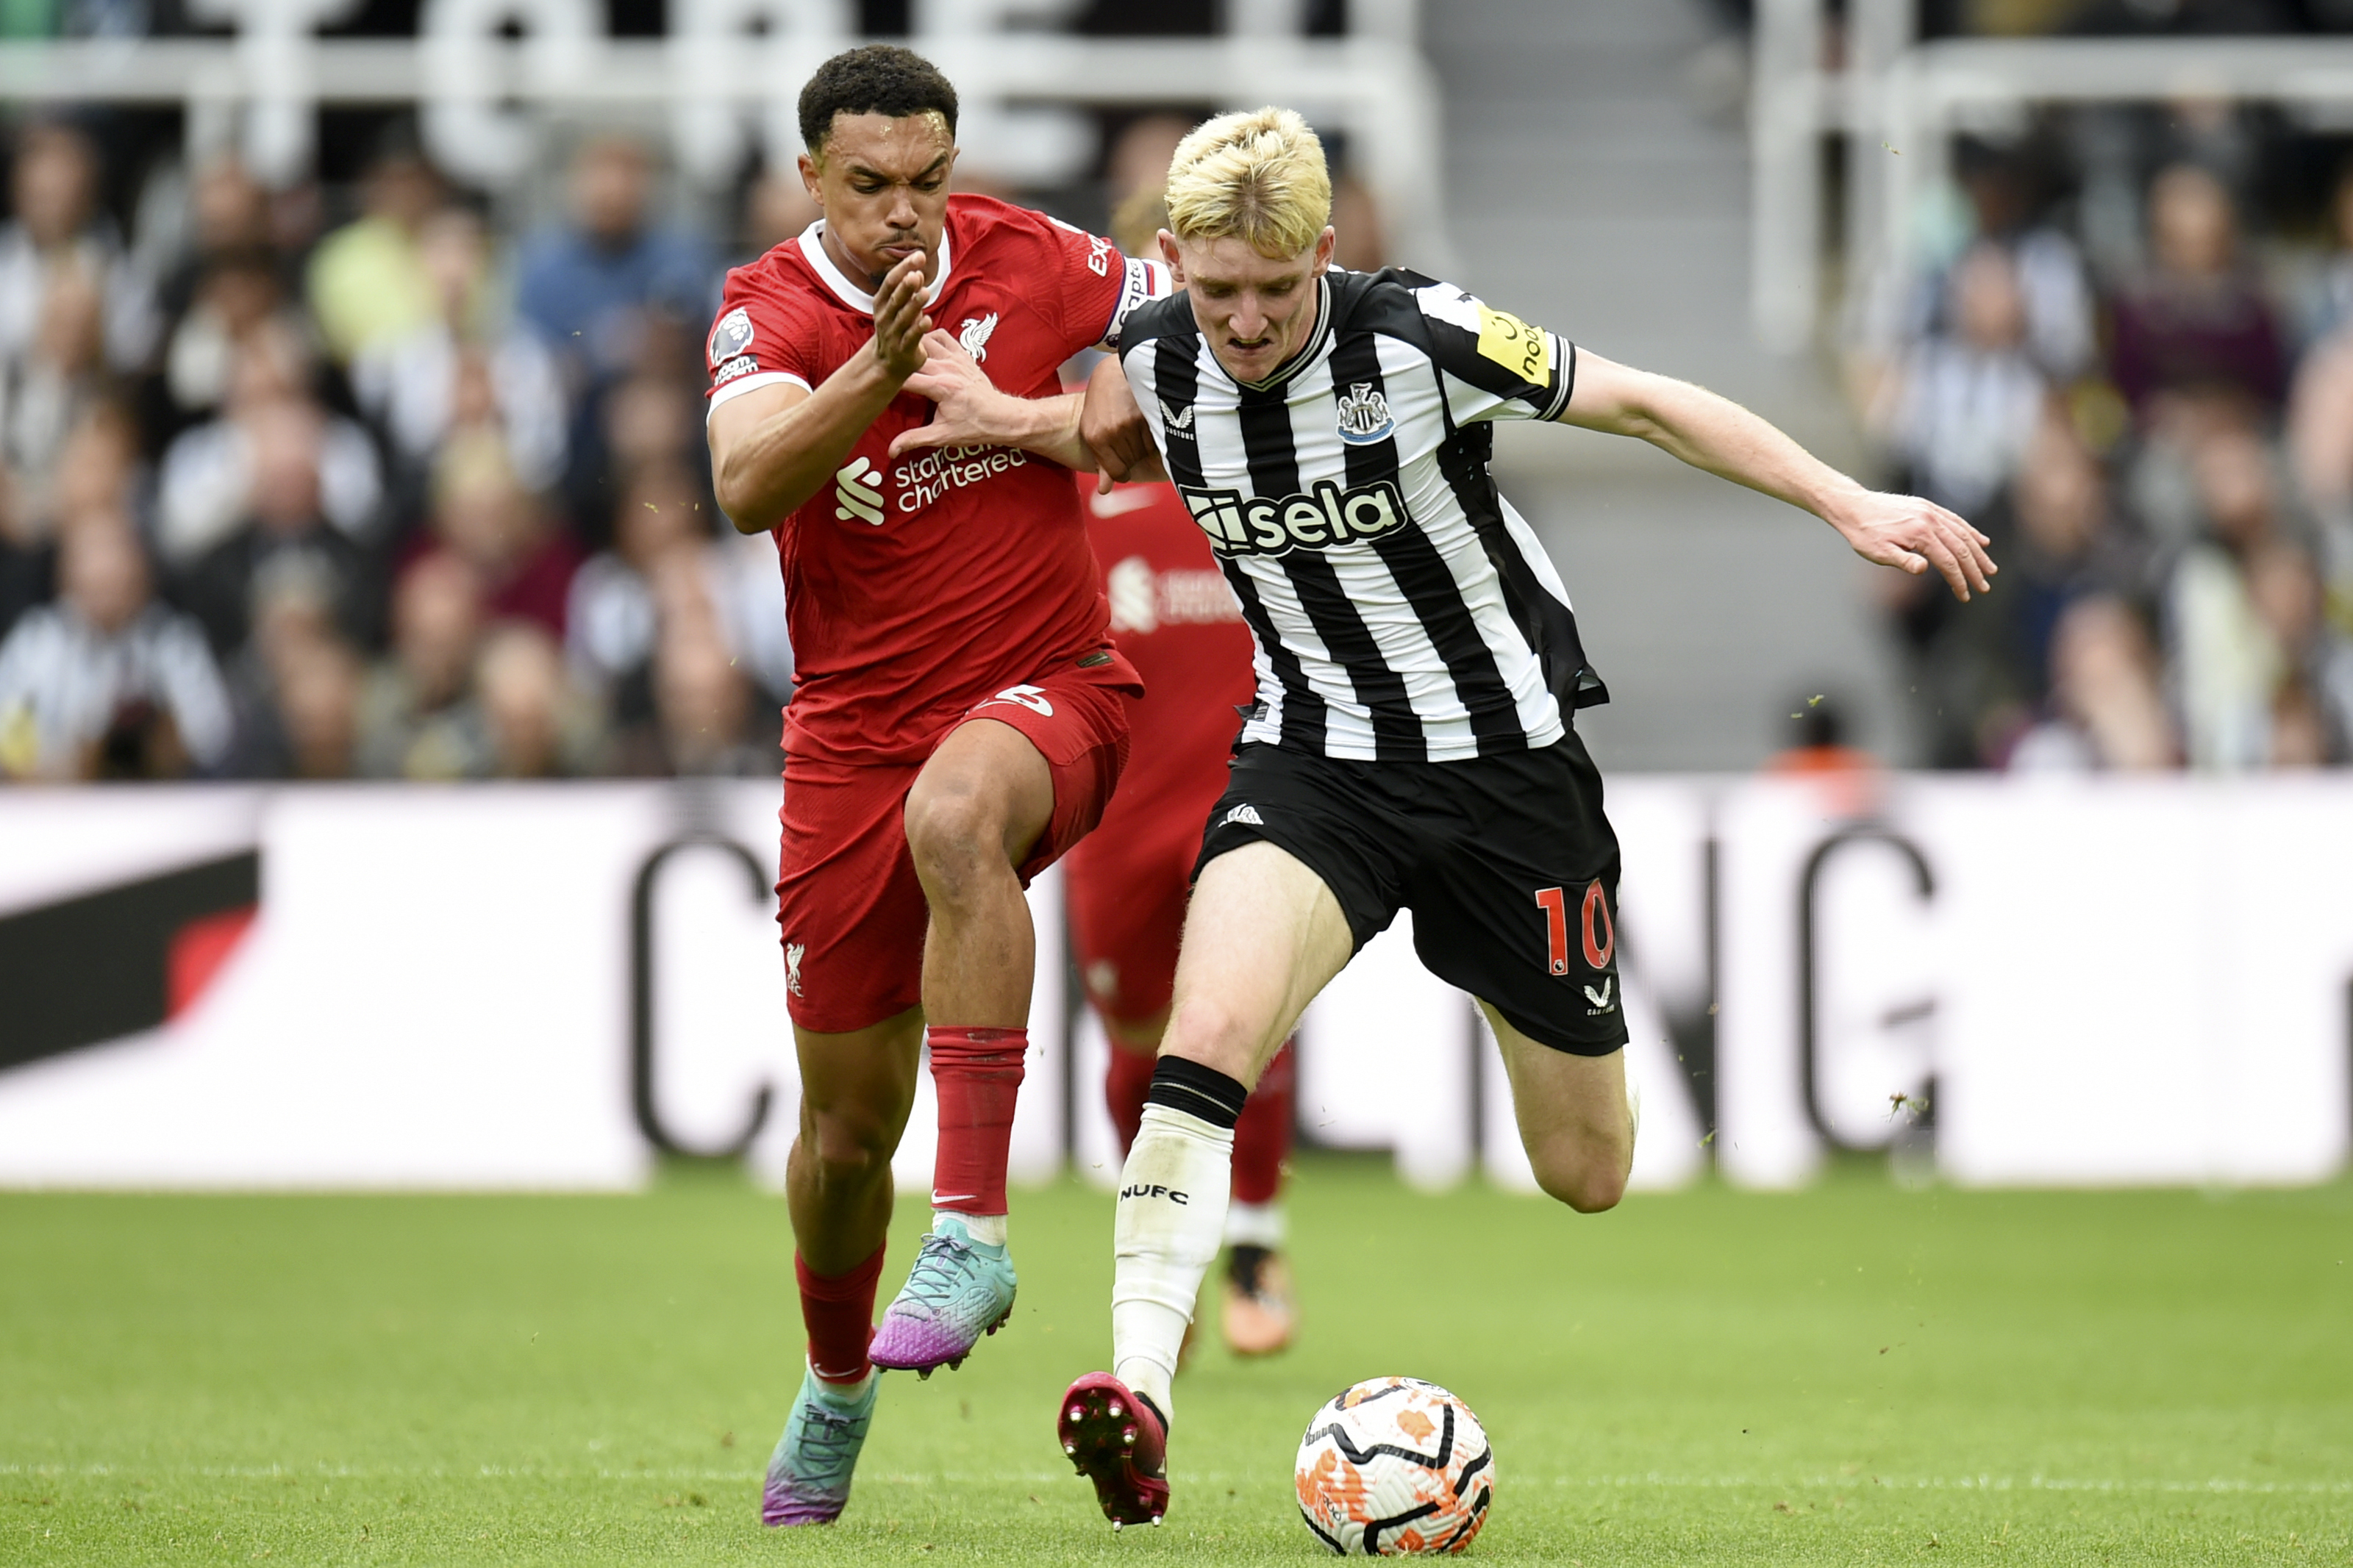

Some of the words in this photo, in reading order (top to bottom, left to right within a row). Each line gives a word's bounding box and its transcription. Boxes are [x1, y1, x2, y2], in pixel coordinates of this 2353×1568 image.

[1521, 321, 1541, 377] noo
[898, 448, 1027, 512] chartered
[1535, 878, 1615, 976] 10
[1120, 1184, 1189, 1206] NUFC
